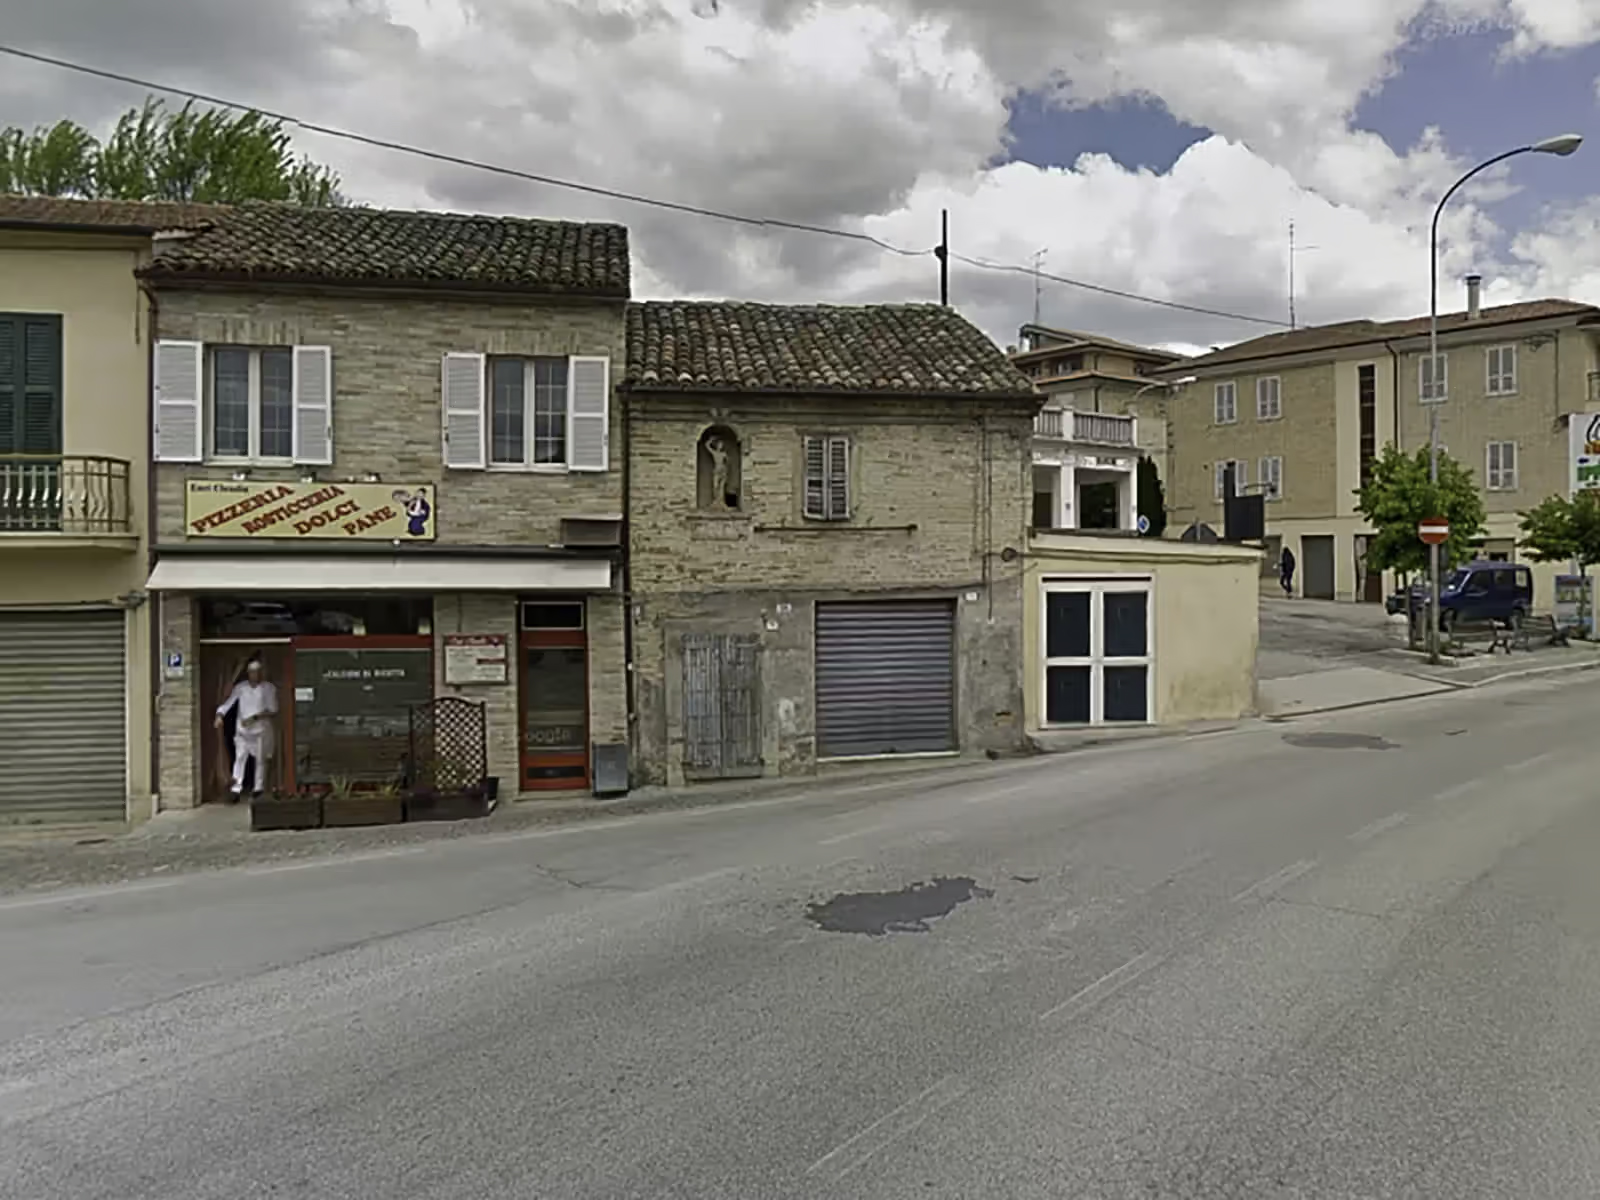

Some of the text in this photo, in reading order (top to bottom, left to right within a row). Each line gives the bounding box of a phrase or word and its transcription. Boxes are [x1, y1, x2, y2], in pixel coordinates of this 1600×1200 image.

[191, 485, 294, 533] PIZZERIA
[241, 485, 345, 534] ROSTICCERIA
[293, 499, 360, 535] DOLCI
[343, 505, 397, 535] PANE
